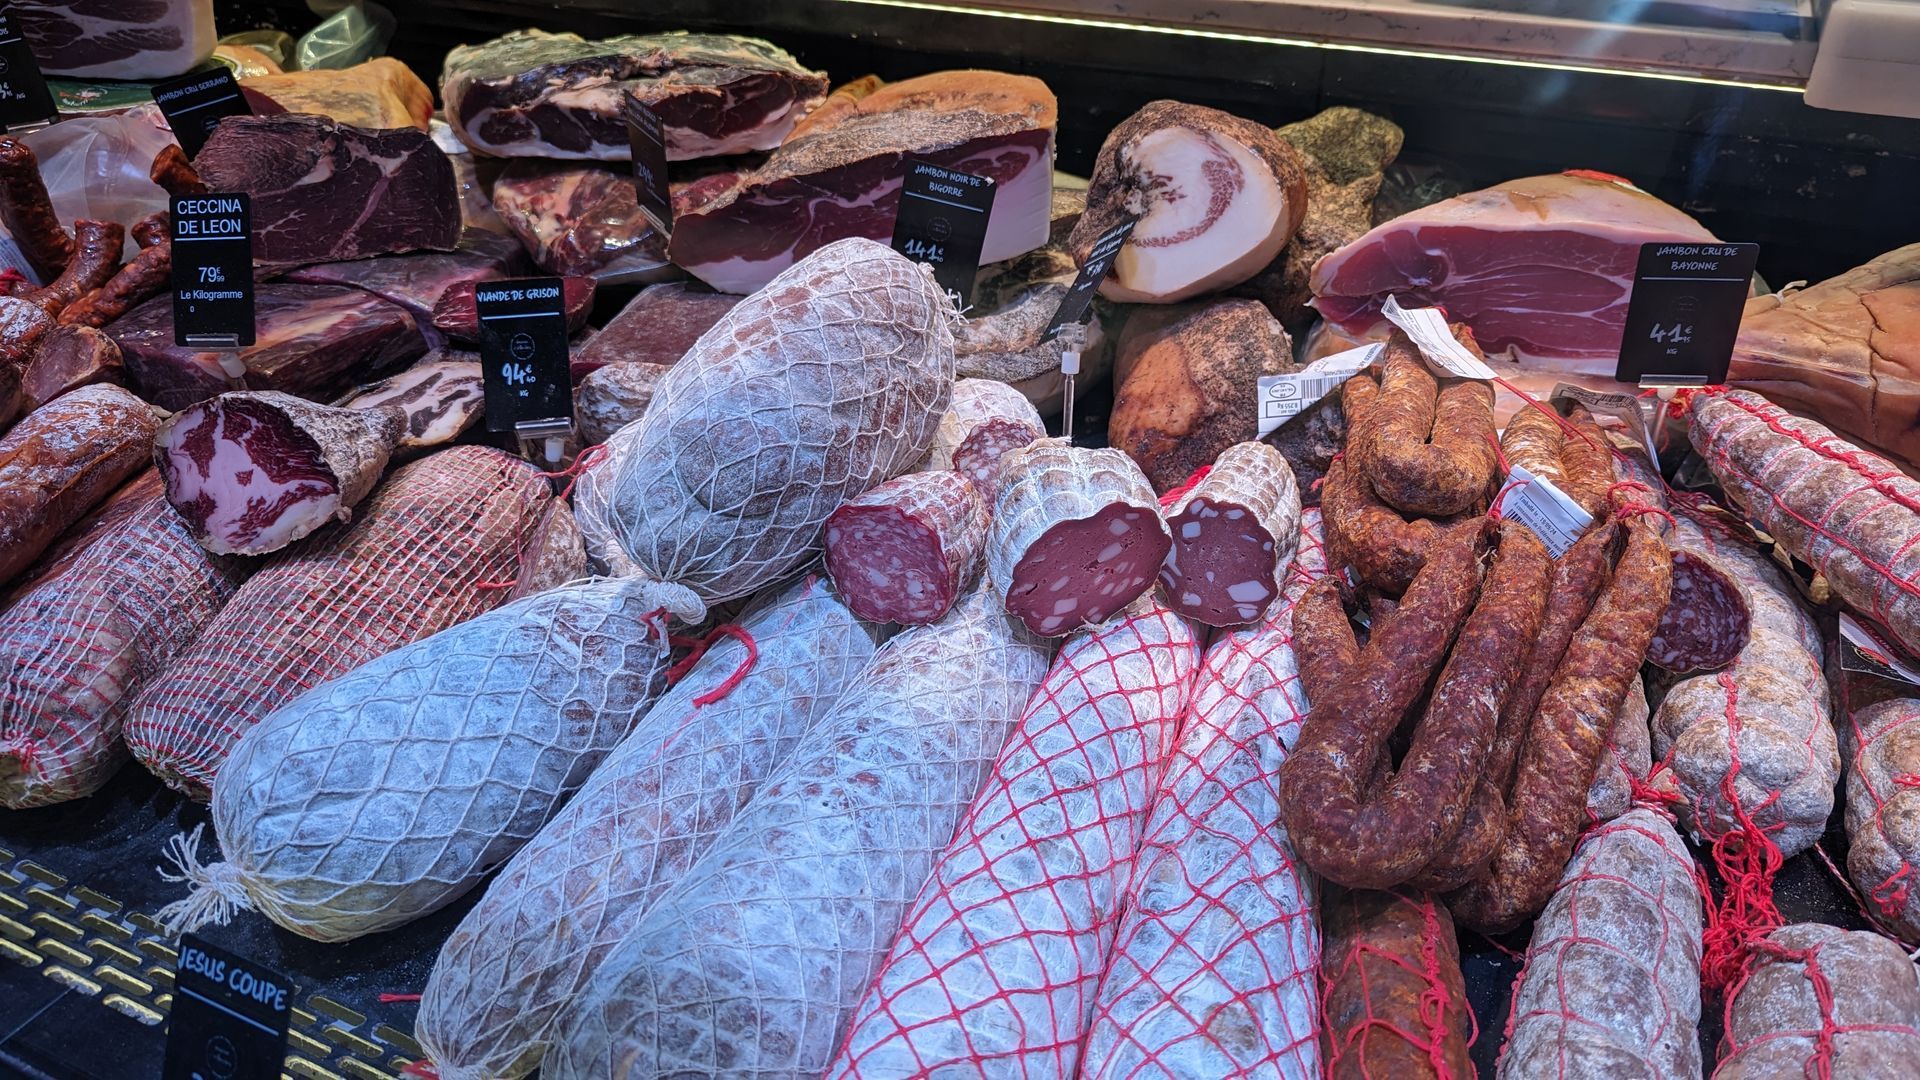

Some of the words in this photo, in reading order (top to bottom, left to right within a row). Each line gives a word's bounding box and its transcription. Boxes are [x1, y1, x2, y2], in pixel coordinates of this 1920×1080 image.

[157, 89, 184, 104] JAMBON
[184, 85, 199, 95] CRU
[198, 76, 229, 90] SERRANO
[914, 164, 948, 179] JAMBON
[949, 172, 968, 185] NOIR
[968, 177, 981, 188] DE
[929, 181, 964, 197] BIGORRE
[177, 198, 242, 215] CECCINA
[178, 220, 198, 234] DE
[202, 219, 241, 234] LEON
[1656, 246, 1699, 257] JAMBON
[1701, 246, 1722, 256] CRU
[1723, 246, 1738, 256] DE
[1671, 261, 1719, 271] BAYONNE
[180, 290, 191, 300] Le
[193, 289, 243, 301] Kilogramme
[476, 289, 511, 303] VIANDE
[511, 289, 524, 301] DE
[526, 287, 560, 300] GRISON
[177, 945, 226, 982] JESUS
[229, 968, 288, 1011] COUPE
